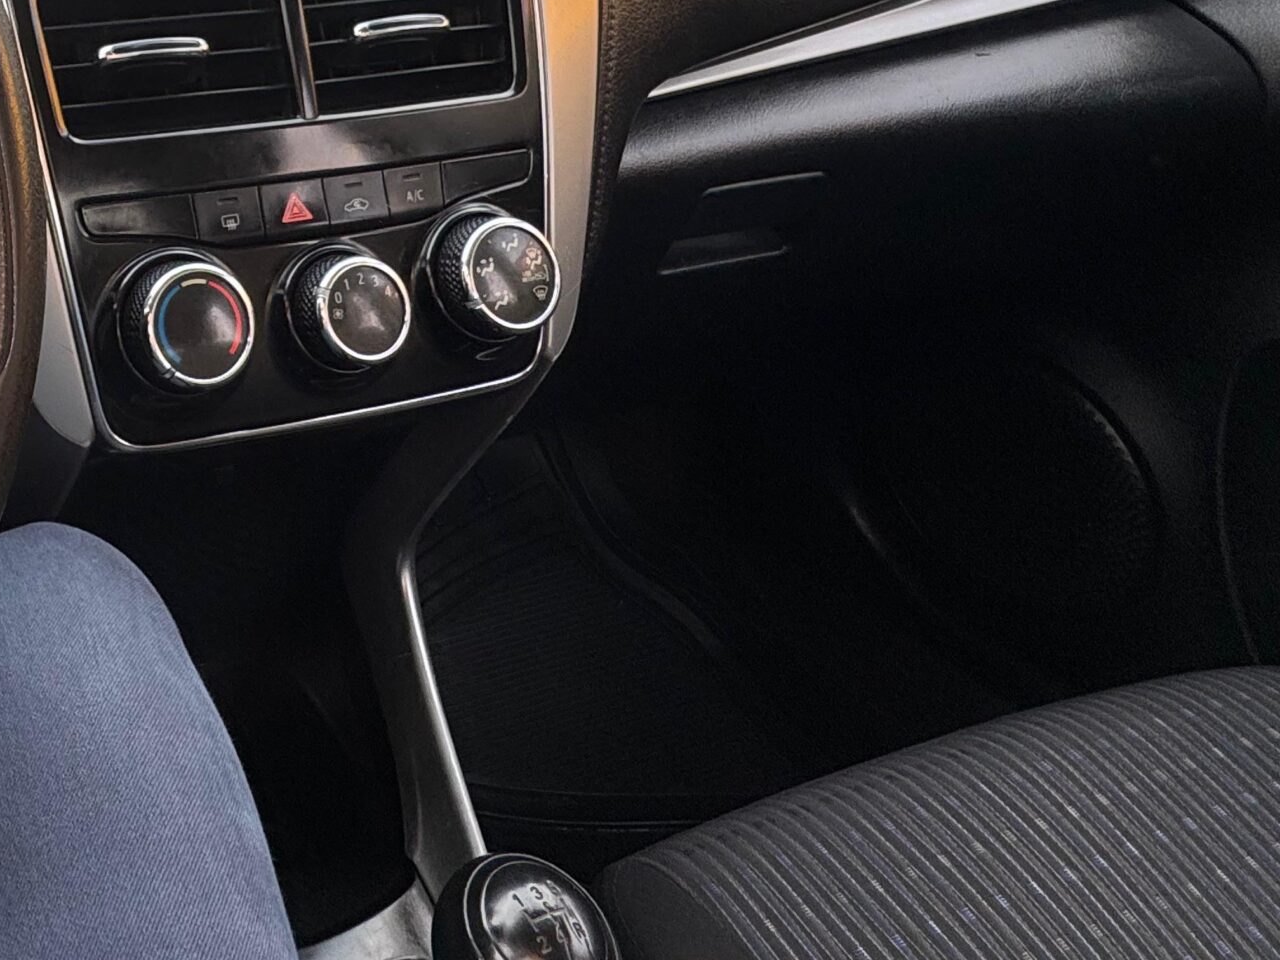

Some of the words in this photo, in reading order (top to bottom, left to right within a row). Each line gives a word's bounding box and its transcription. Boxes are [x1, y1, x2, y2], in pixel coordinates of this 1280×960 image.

[406, 189, 424, 203] A/C
[344, 278, 350, 291] 1
[357, 272, 365, 285] 2
[371, 274, 380, 287] 3
[334, 291, 342, 304] 0
[529, 885, 544, 901] 3
[512, 893, 525, 908] 1
[535, 935, 553, 955] 2
